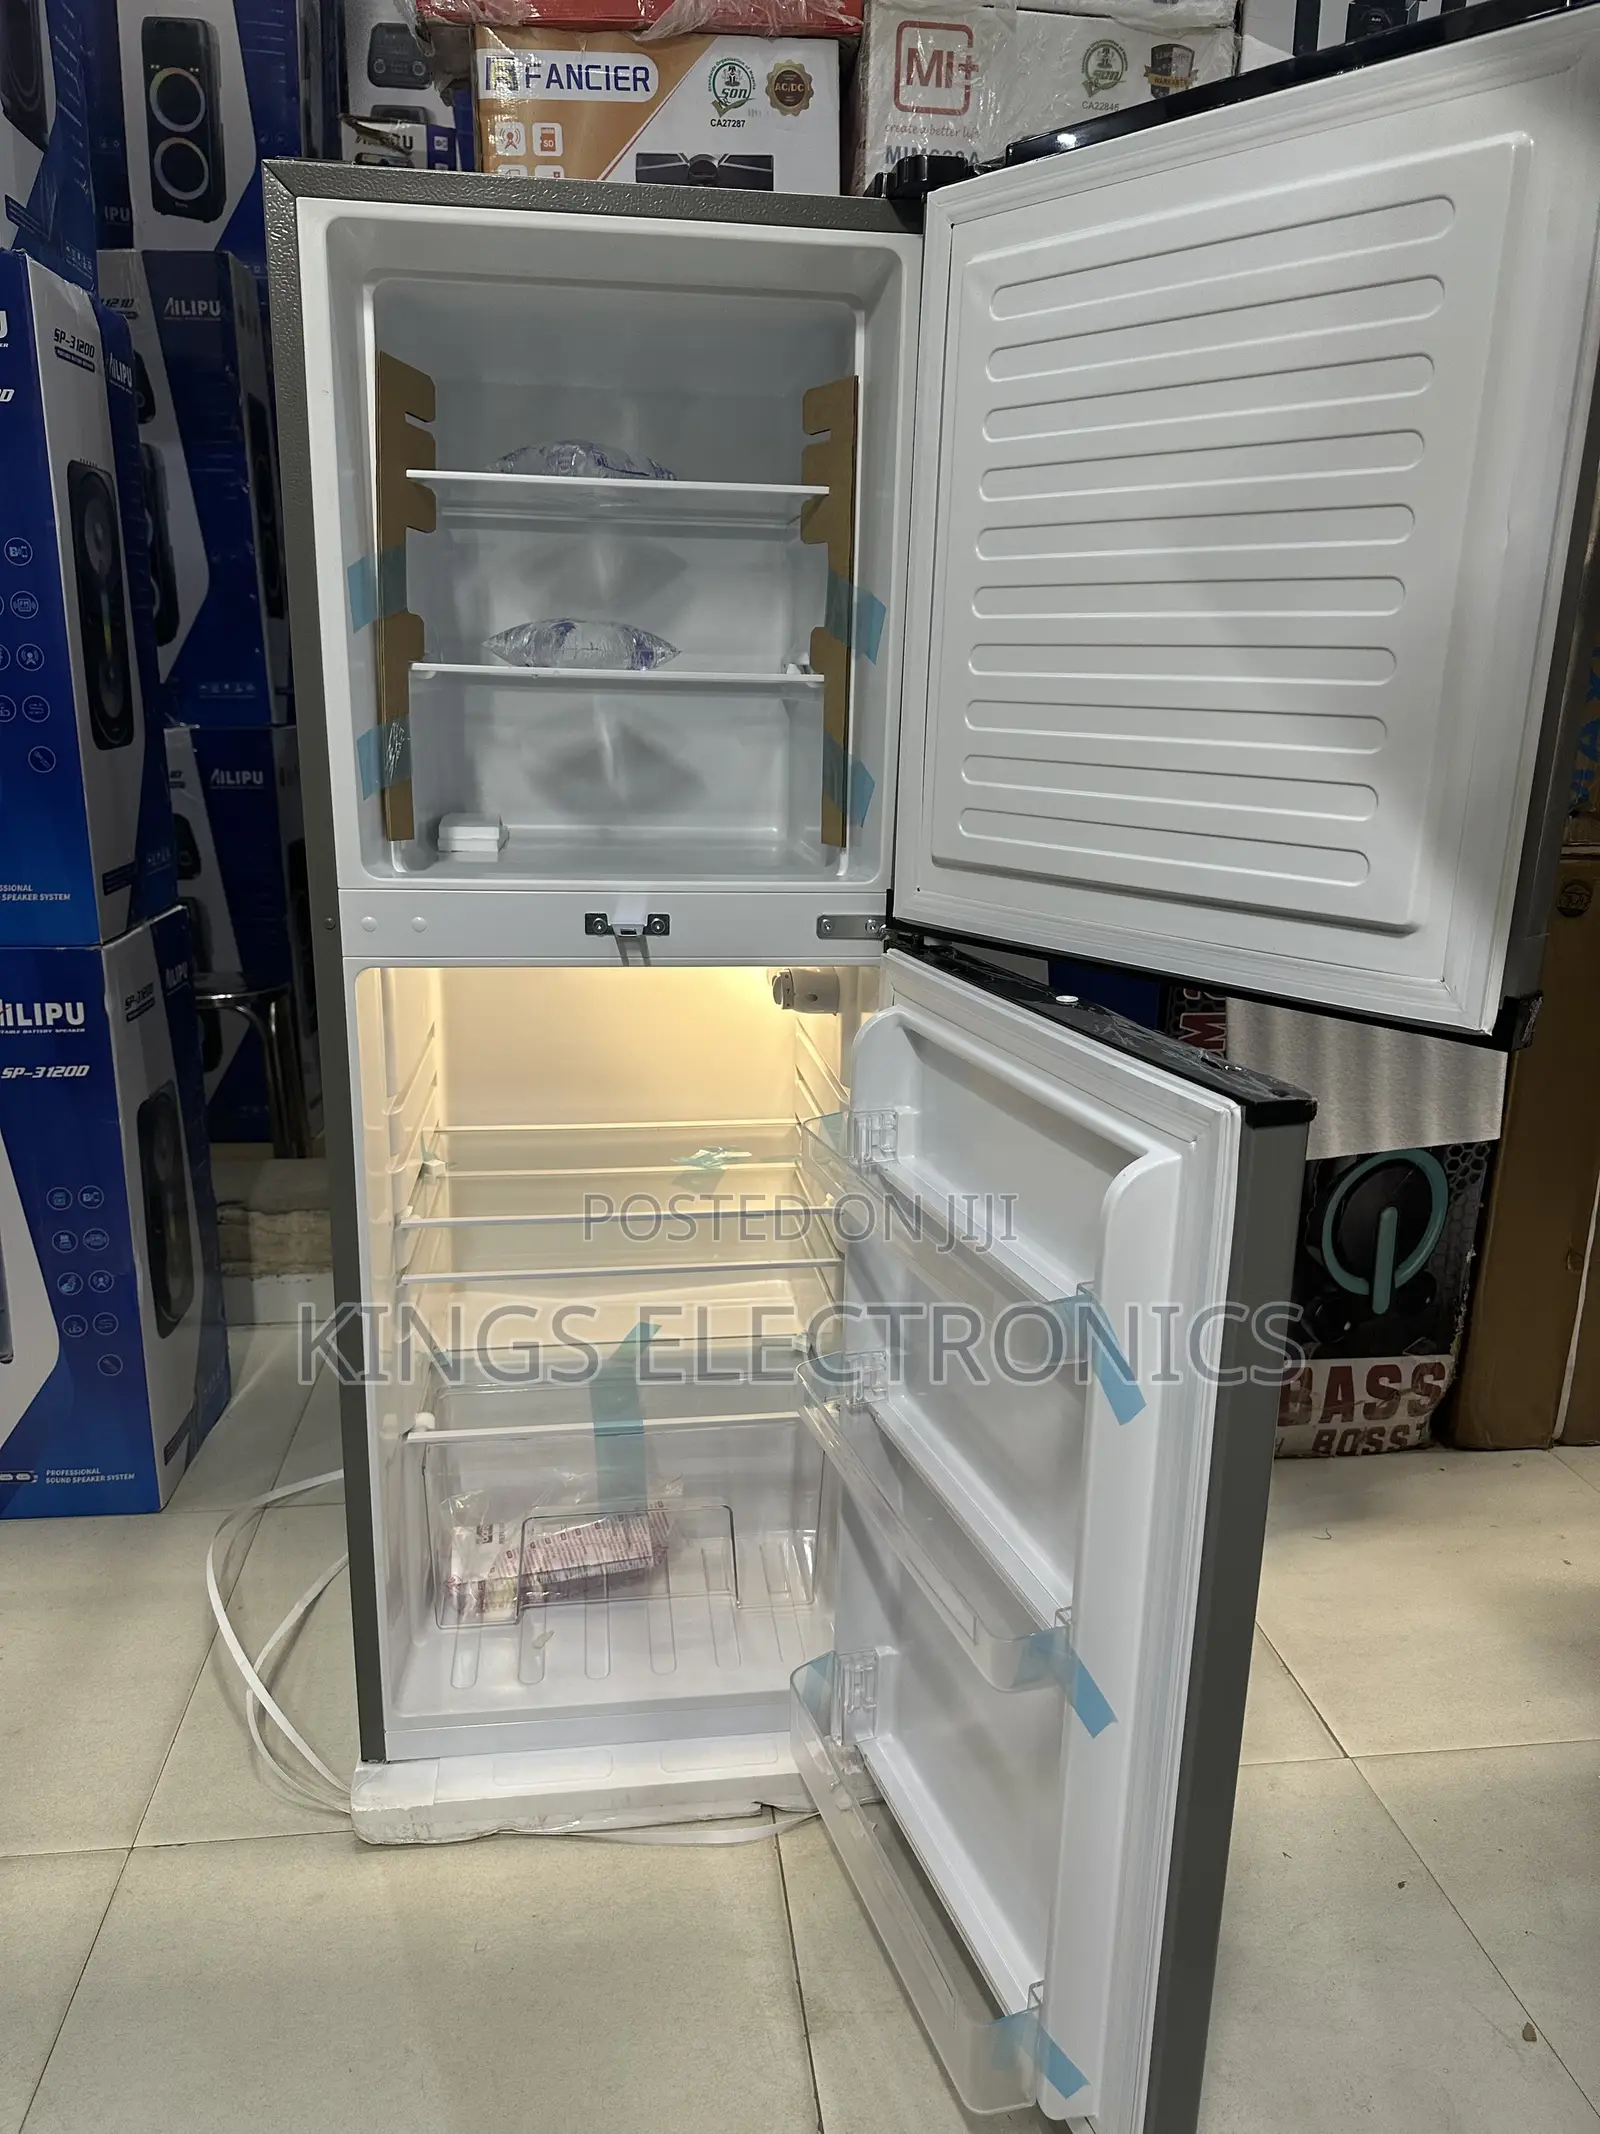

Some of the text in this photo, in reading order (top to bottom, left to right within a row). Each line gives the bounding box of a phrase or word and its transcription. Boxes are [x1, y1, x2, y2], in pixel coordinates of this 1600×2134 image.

[525, 63, 651, 92] FANCIER
[774, 82, 805, 93] AC/DC
[710, 118, 746, 128] CA27287
[930, 124, 961, 137] better
[104, 205, 130, 221] IPU
[164, 297, 222, 317] AILIPU
[209, 768, 265, 785] AILIPU
[2, 893, 39, 901] SPEAKER
[1277, 1361, 1446, 1427] BASS
[1311, 1423, 1411, 1457] BOSS
[45, 1467, 101, 1477] PROFESSIONAL
[72, 1474, 106, 1484] SPEAKER
[106, 1472, 135, 1481] SYSTEM
